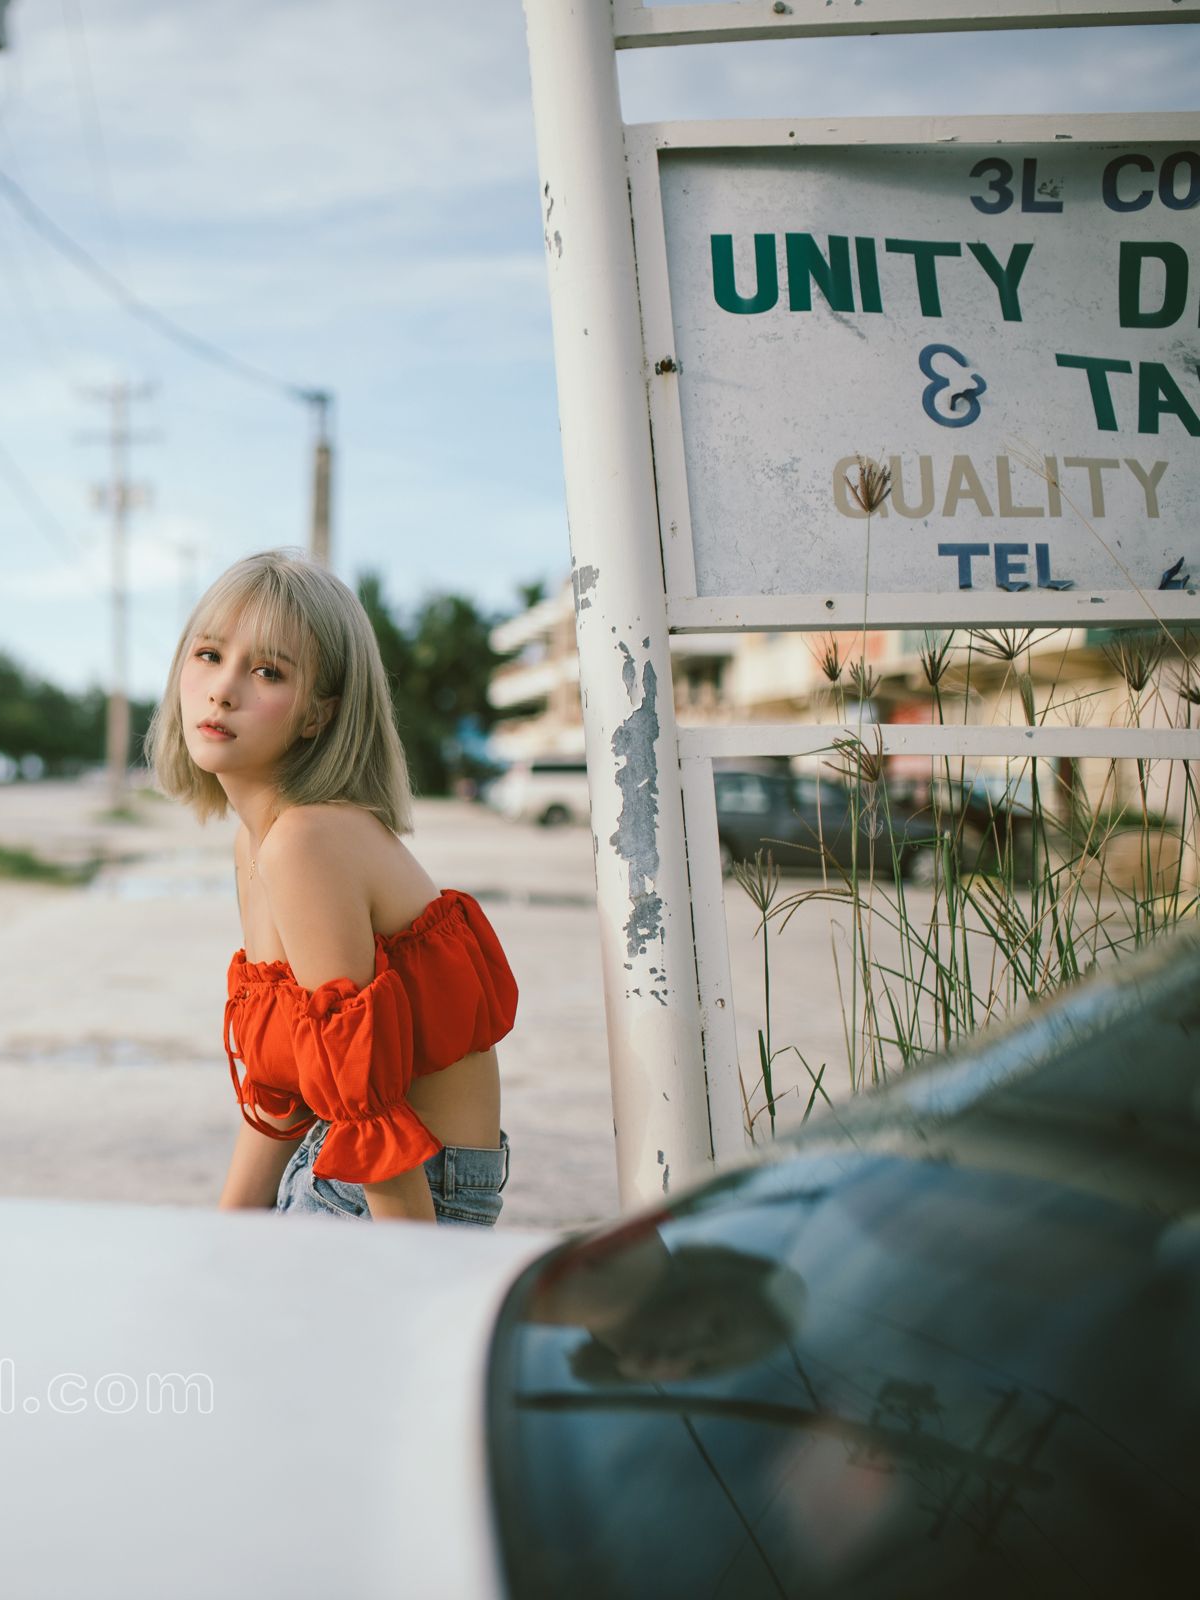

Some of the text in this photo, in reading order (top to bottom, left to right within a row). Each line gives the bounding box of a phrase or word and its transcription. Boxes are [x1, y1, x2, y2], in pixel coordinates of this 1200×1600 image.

[969, 157, 1064, 215] 3L
[710, 233, 1200, 329] UNITY D
[918, 343, 1200, 437] & TA
[832, 454, 1169, 519] QUALITY
[937, 543, 1074, 592] TEL
